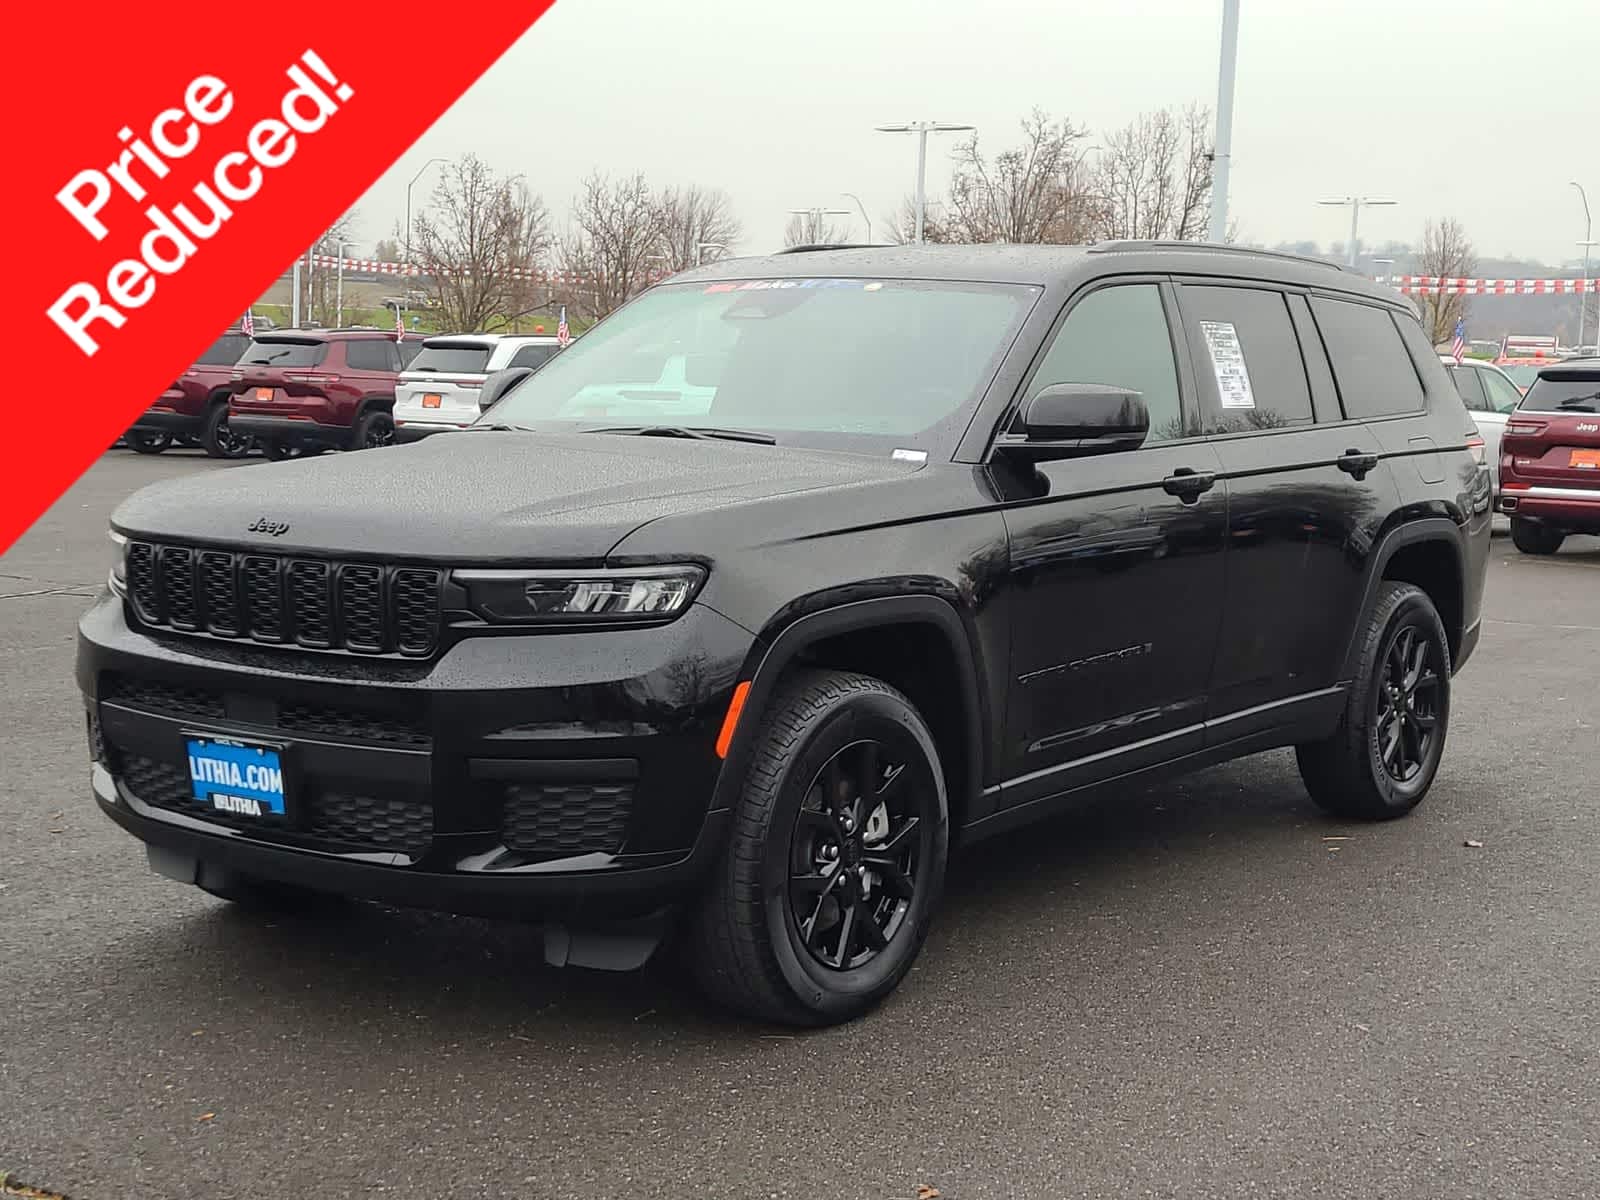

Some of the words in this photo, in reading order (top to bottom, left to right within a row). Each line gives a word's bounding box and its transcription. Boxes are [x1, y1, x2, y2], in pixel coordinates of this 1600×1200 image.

[1576, 422, 1598, 433] Jeep
[247, 517, 290, 537] Jeep
[188, 755, 283, 794] LITHIA.COM
[225, 795, 262, 816] LITHIA
